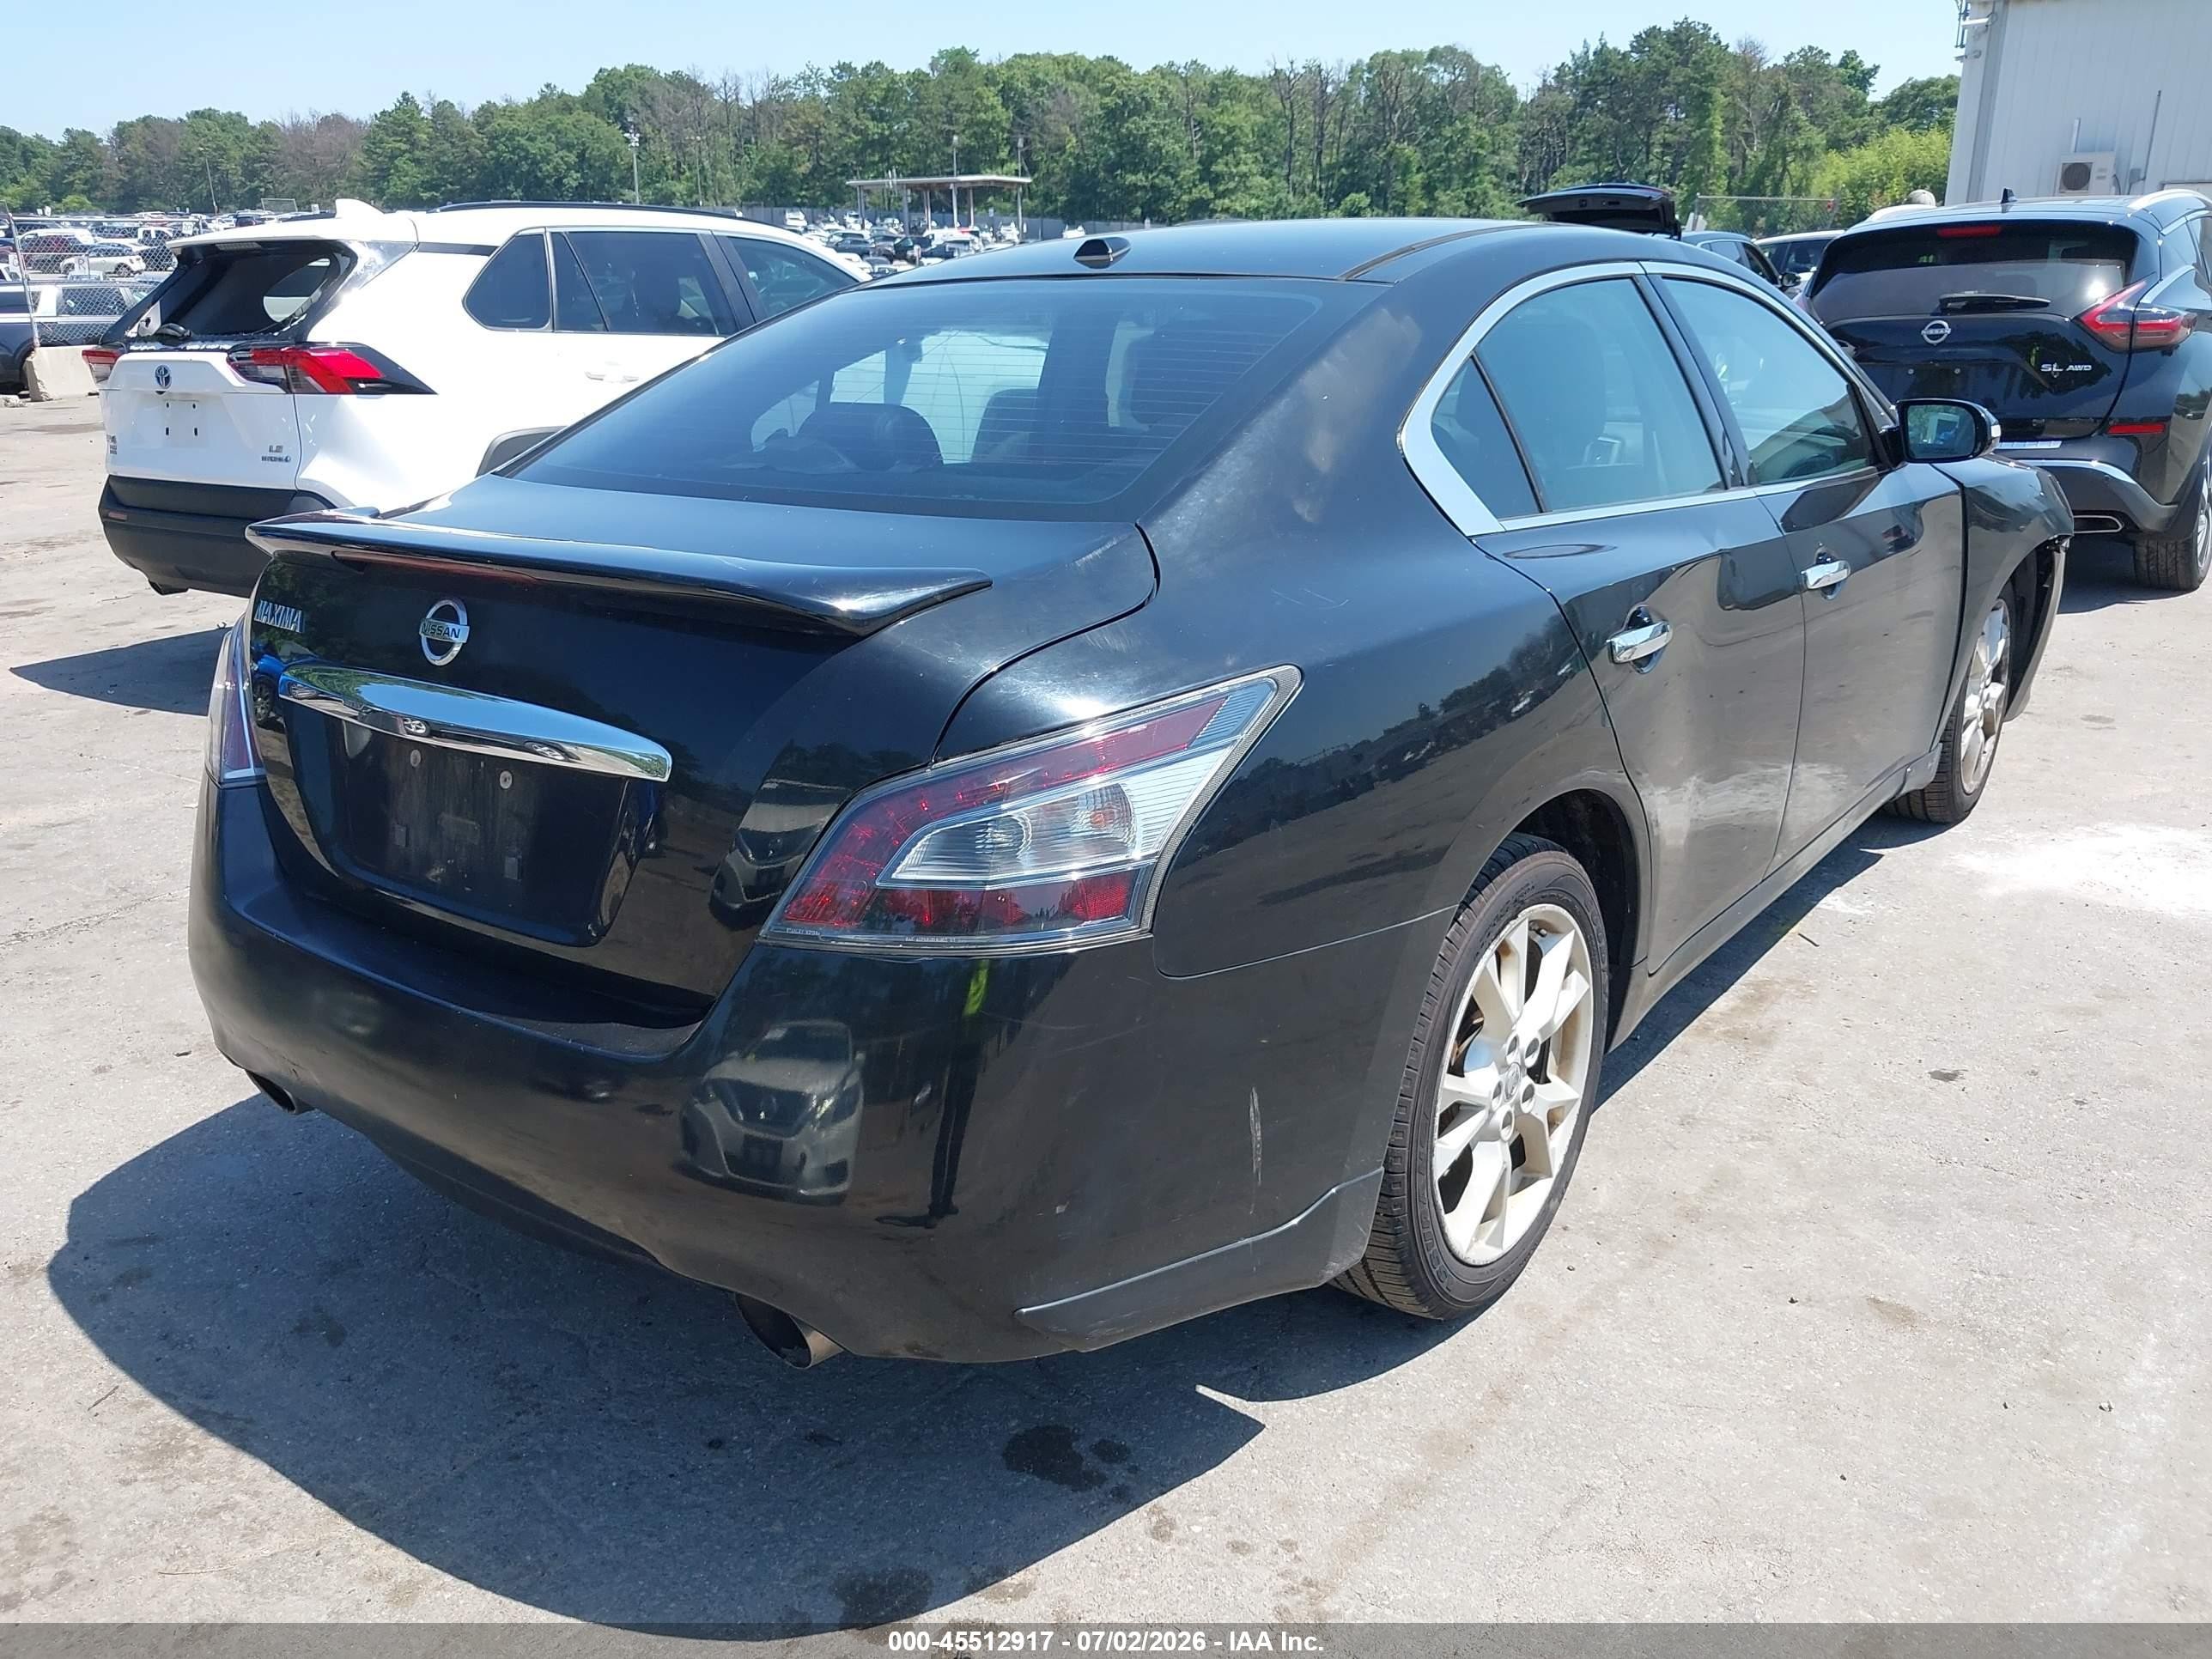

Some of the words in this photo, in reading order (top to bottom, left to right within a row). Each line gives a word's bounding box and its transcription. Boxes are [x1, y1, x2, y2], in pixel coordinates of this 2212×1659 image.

[77, 258, 86, 270] R
[2040, 362, 2063, 372] SL
[254, 599, 305, 633] MAXIMA
[422, 622, 461, 640] NISSAN
